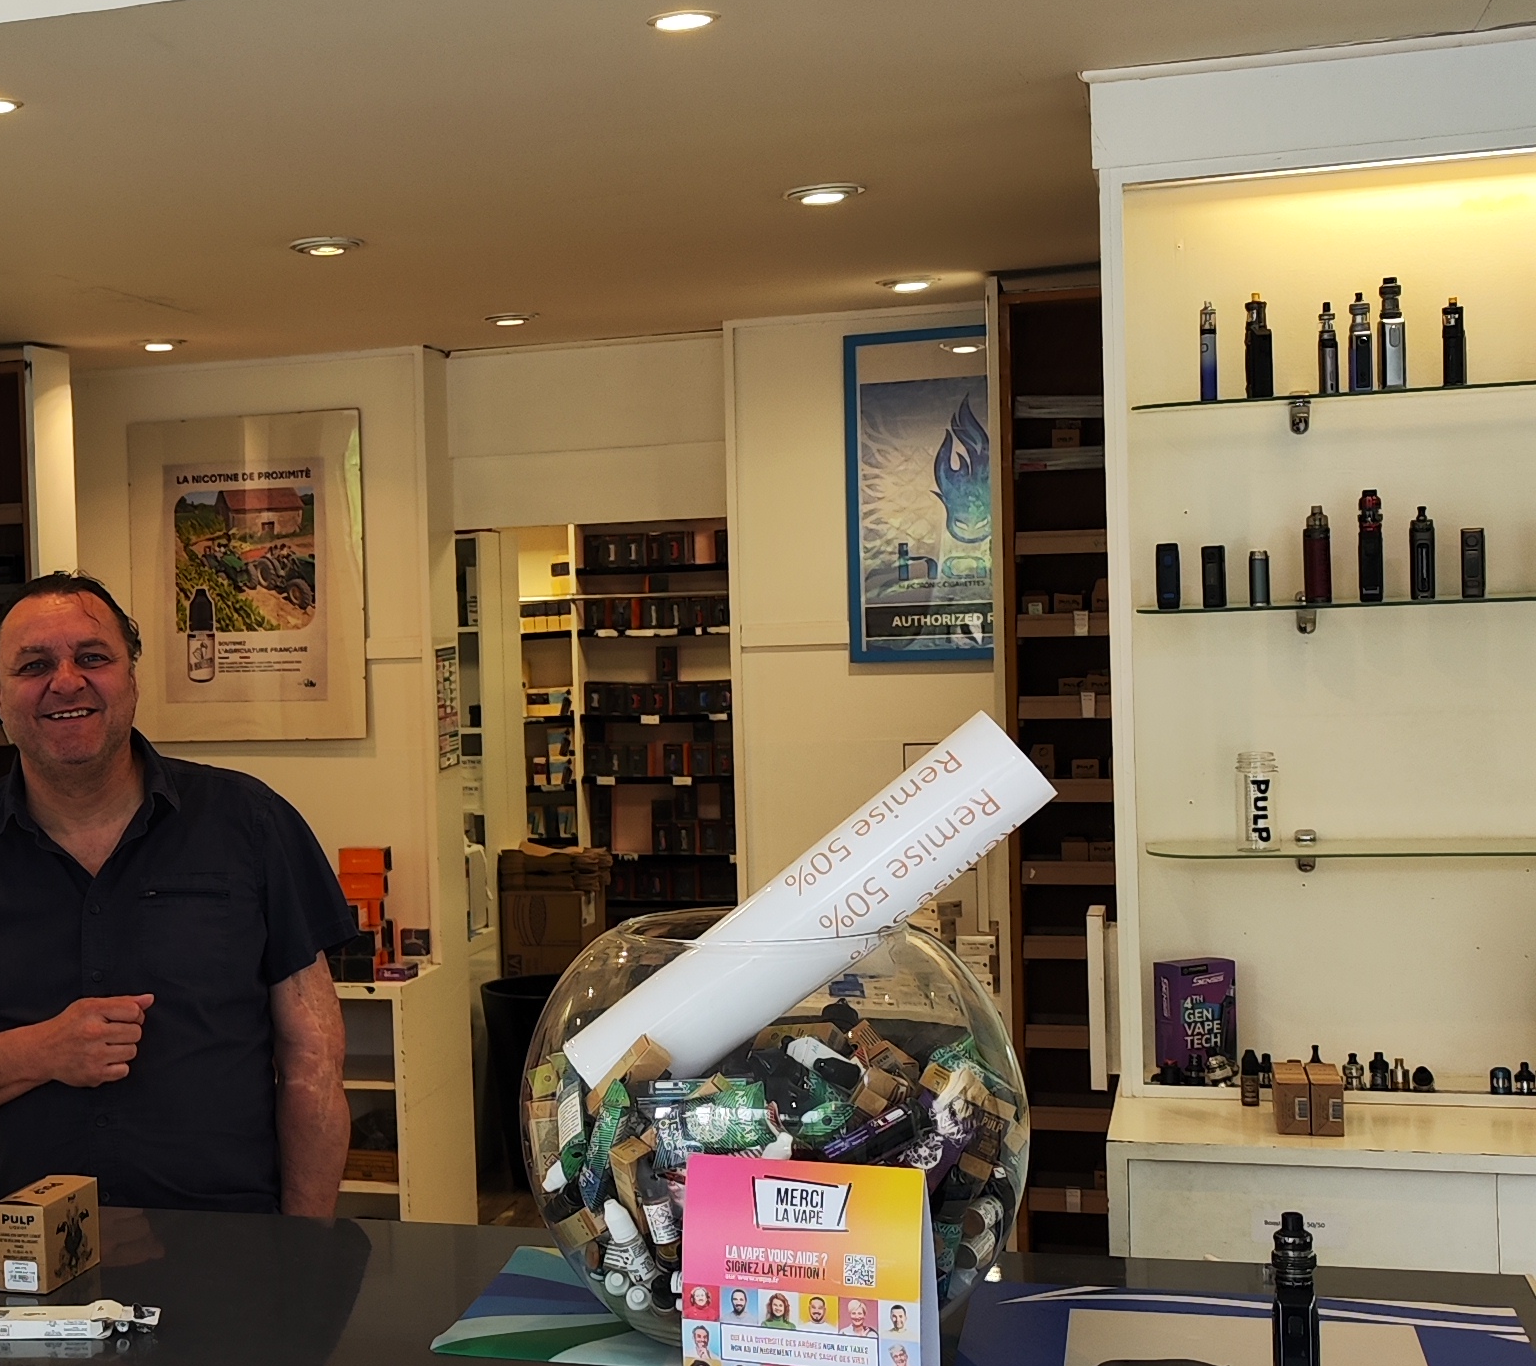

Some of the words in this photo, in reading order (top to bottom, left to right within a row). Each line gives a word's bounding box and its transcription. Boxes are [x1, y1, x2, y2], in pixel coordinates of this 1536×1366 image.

[176, 475, 189, 485] LA
[191, 472, 240, 484] NICOTINE
[241, 471, 255, 482] DE
[257, 467, 311, 481] PROXIMITÉ
[892, 613, 984, 627] AUTHORIZED
[851, 750, 963, 837] Remise
[1250, 779, 1271, 843] PULP
[886, 788, 1002, 881] Remise
[784, 836, 852, 897] 50%
[819, 877, 890, 938] 50%
[1184, 995, 1204, 1009] 4TH
[1184, 1008, 1212, 1022] GEN
[1184, 1020, 1222, 1035] VAPE
[1184, 1033, 1221, 1049] TECH
[982, 1116, 1004, 1133] PULP
[775, 1187, 825, 1209] MERCI
[2, 1213, 35, 1225] PULP
[775, 1207, 791, 1223] LA
[793, 1208, 824, 1226] VAPE
[726, 1245, 738, 1259] LA
[740, 1246, 765, 1262] VAPE
[767, 1248, 793, 1264] VOUS
[795, 1251, 819, 1265] AIDE
[821, 1252, 828, 1266] ?
[725, 1260, 759, 1274] SIGNEZ
[762, 1263, 774, 1275] LA
[776, 1262, 820, 1279] PÉTITION
